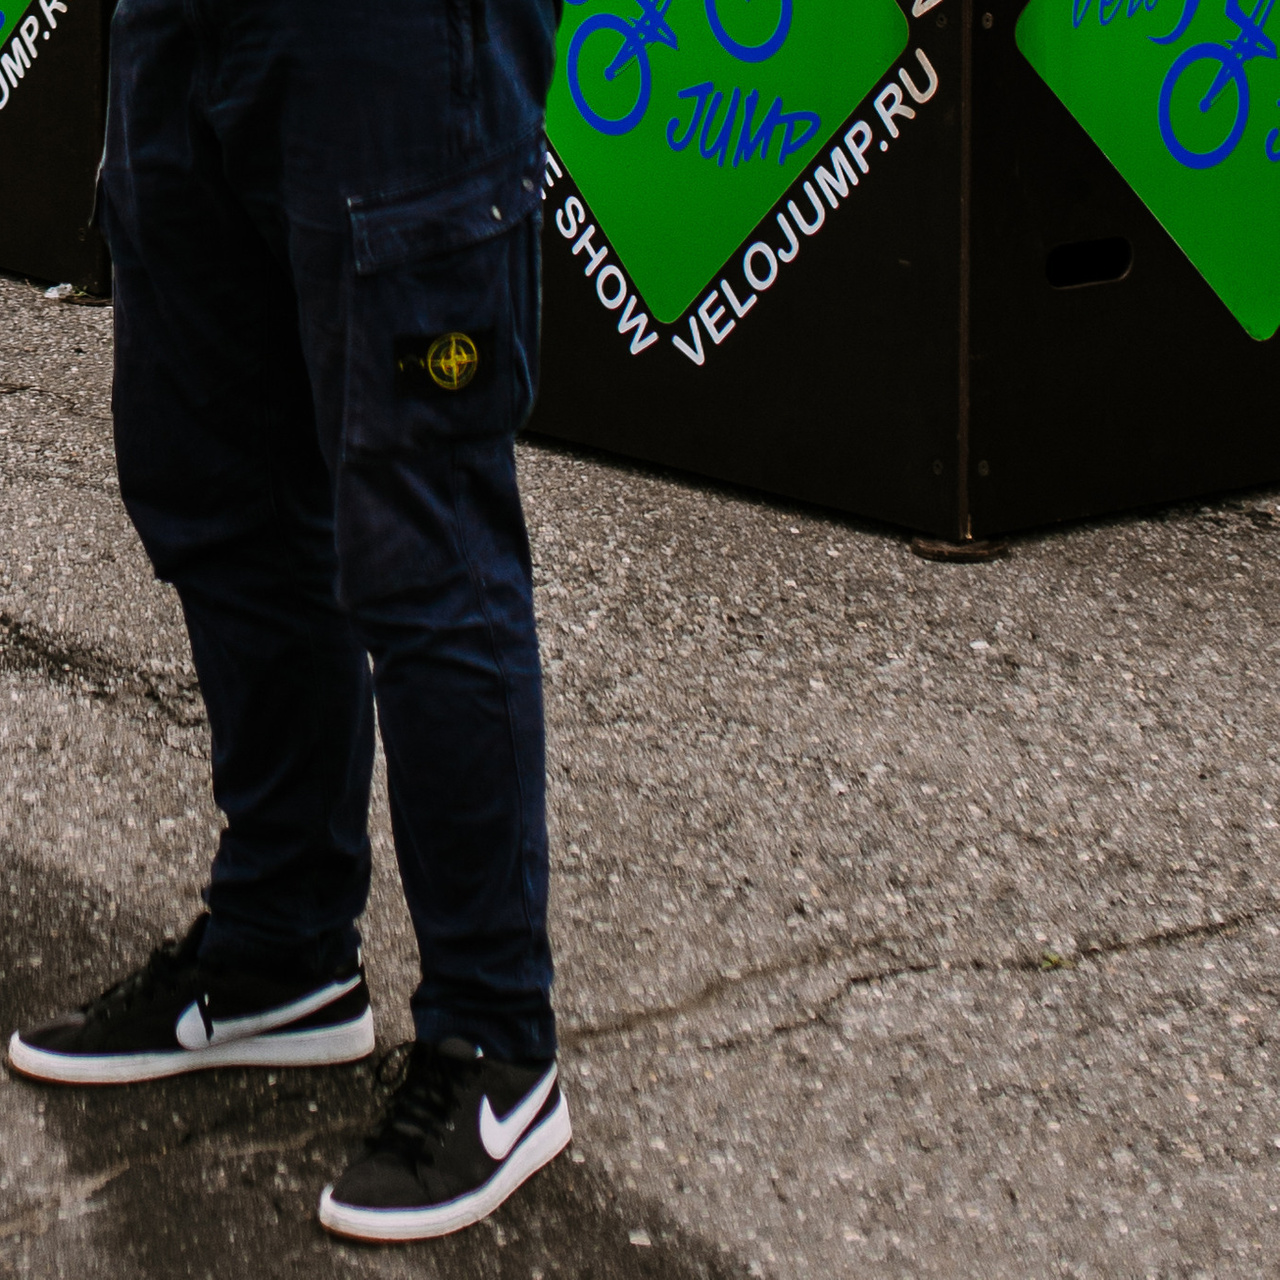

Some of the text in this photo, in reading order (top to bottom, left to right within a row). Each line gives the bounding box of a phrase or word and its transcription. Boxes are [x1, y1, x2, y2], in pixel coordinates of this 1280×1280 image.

[665, 81, 822, 168] JUMP
[555, 195, 660, 356] SHOW
[672, 48, 940, 367] VELOJUMP.RU
